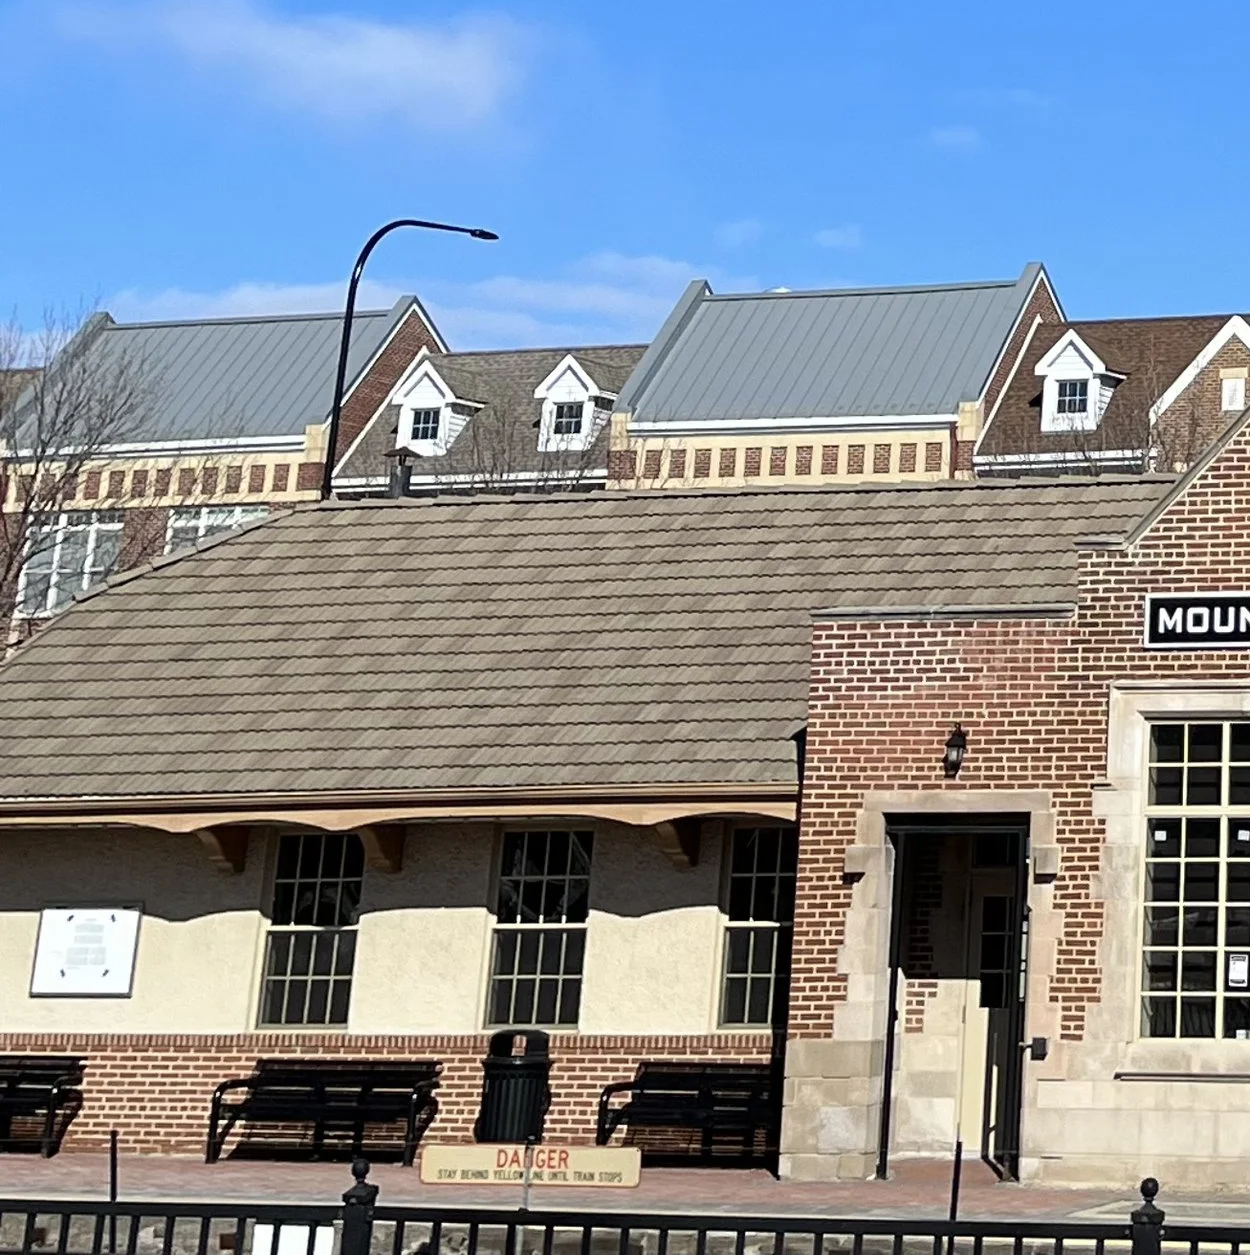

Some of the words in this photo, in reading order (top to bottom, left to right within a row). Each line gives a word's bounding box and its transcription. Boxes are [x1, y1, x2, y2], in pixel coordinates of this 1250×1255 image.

[437, 1169, 457, 1180] STAY
[460, 1169, 489, 1180] BEHIND
[573, 1171, 595, 1182] TRAIN
[599, 1171, 622, 1183] STOPS
